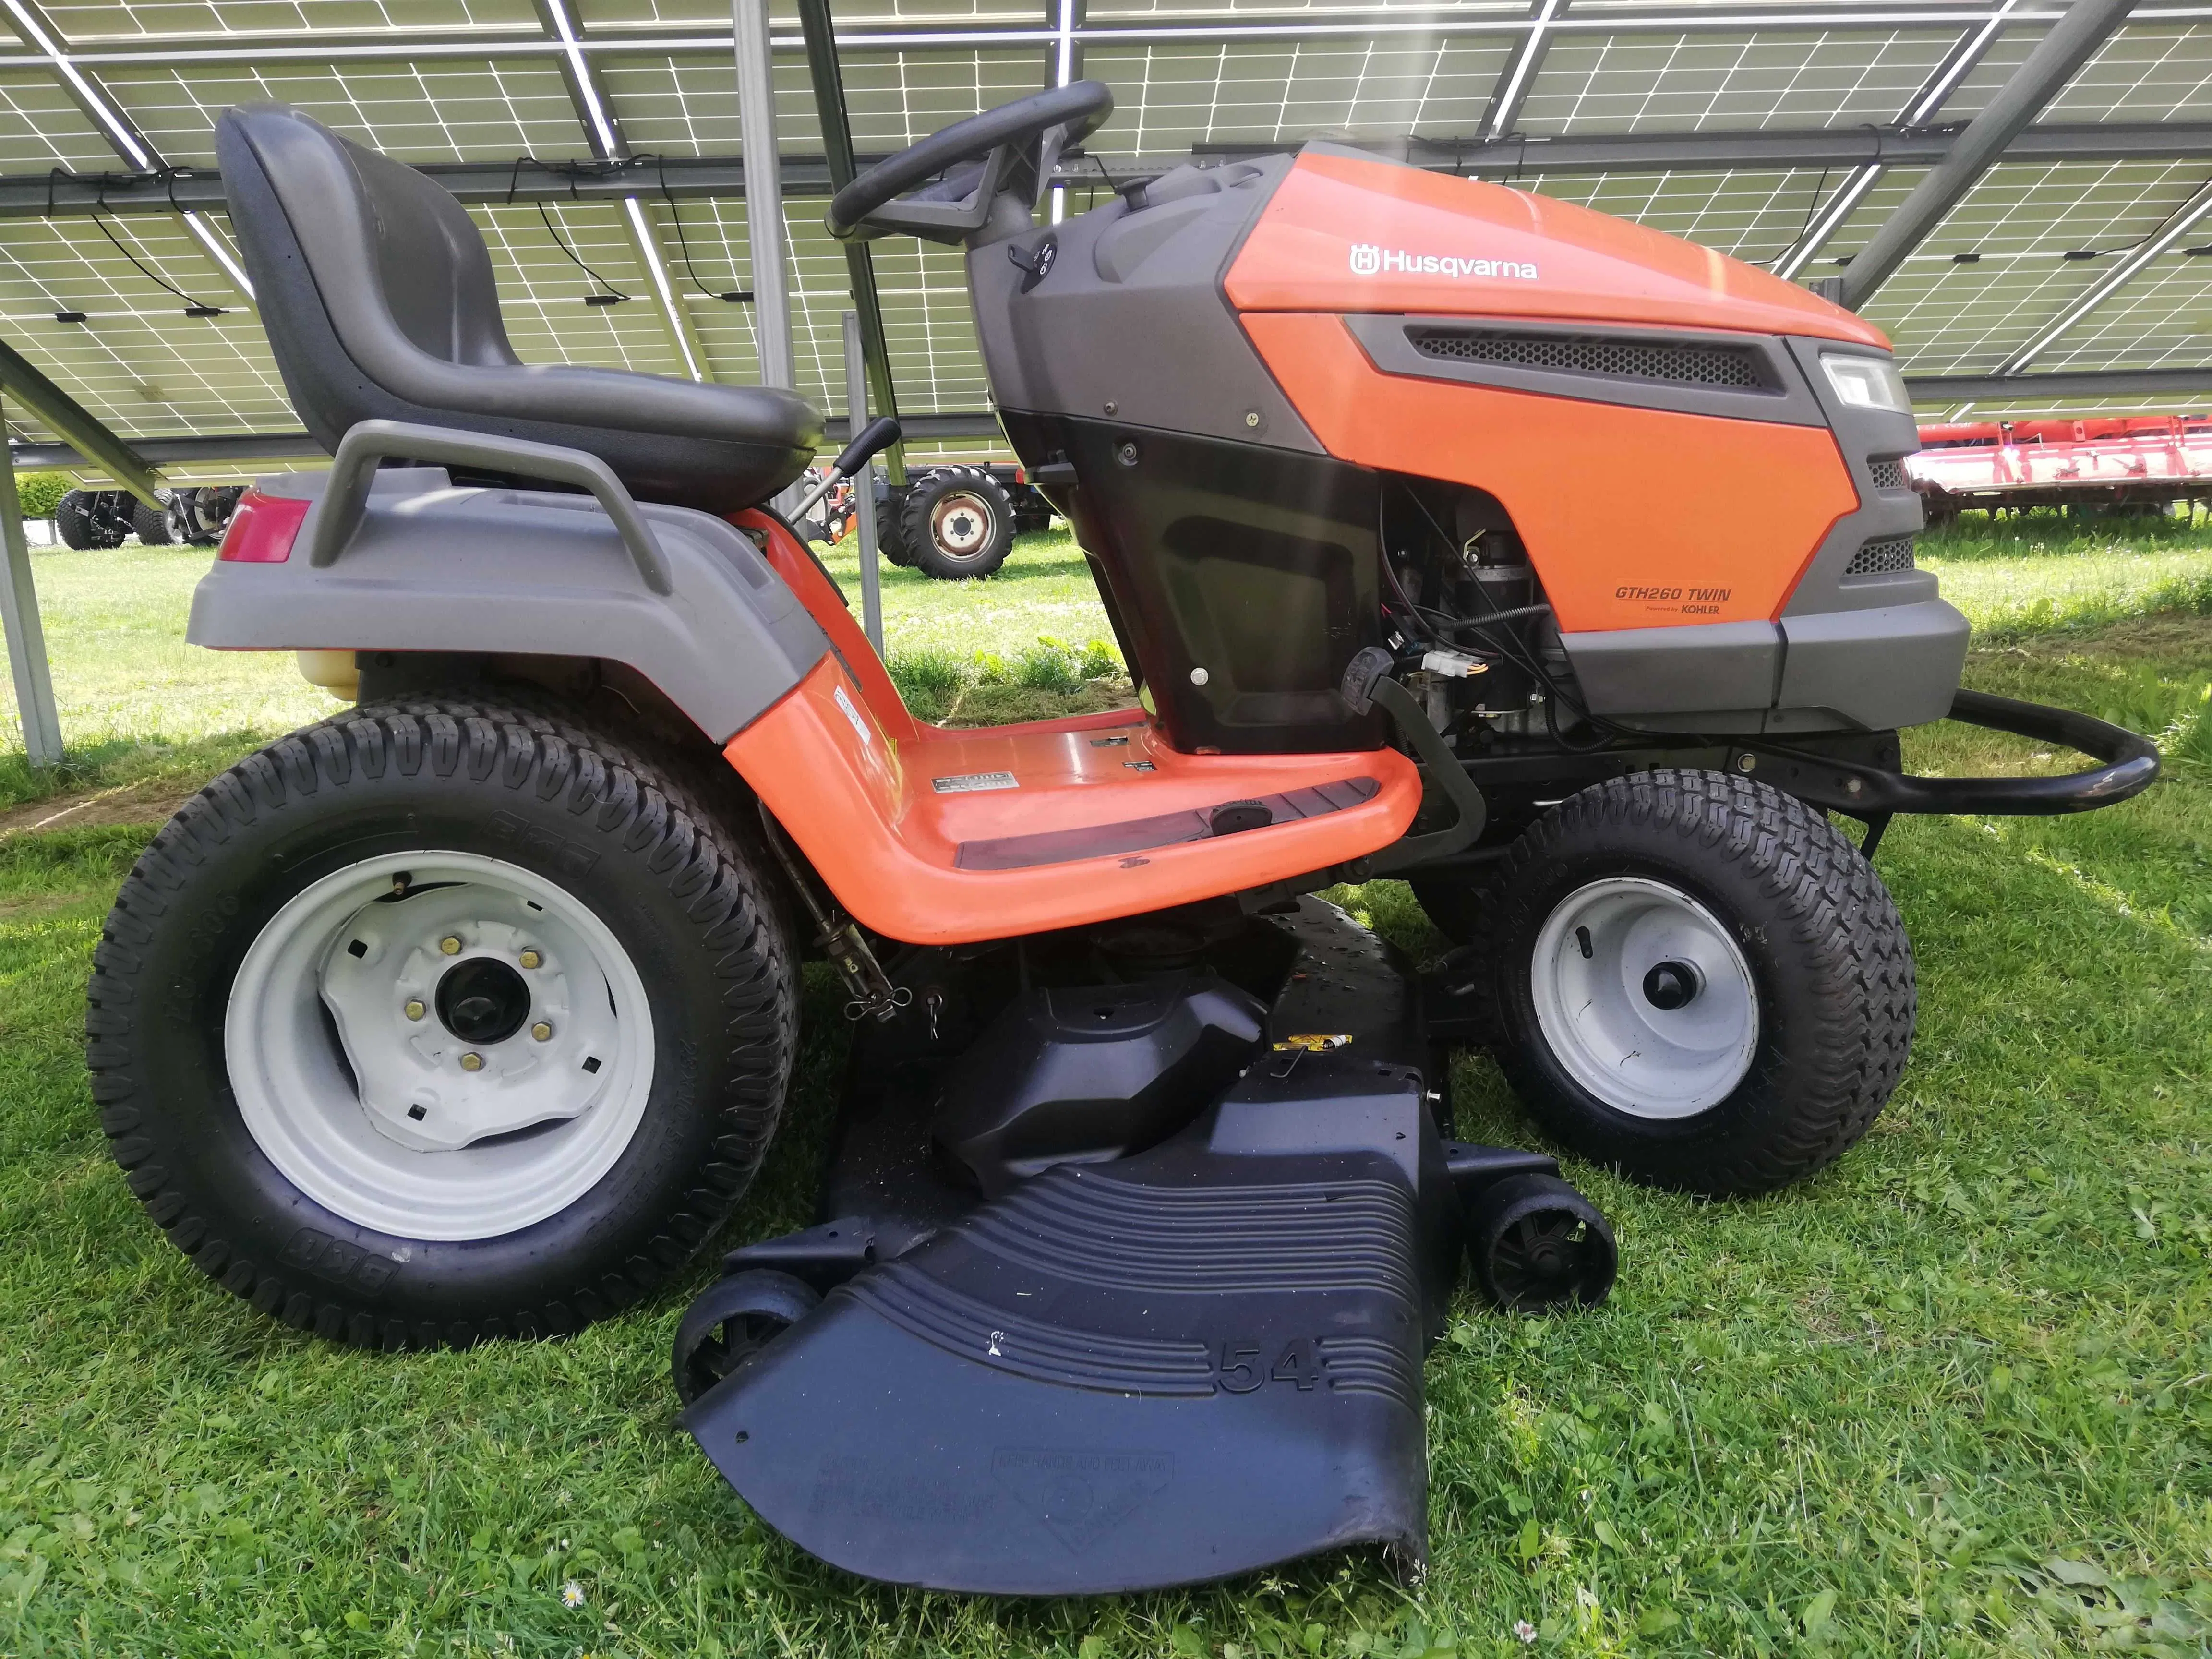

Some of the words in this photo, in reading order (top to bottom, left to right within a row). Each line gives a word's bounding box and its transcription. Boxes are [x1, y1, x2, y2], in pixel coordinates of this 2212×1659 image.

[1383, 249, 1537, 279] Husqvarna
[1616, 587, 1682, 600] GTH260
[1688, 588, 1731, 601] TWIN
[1682, 605, 1719, 614] KOHLER
[1217, 1338, 1319, 1394] 54
